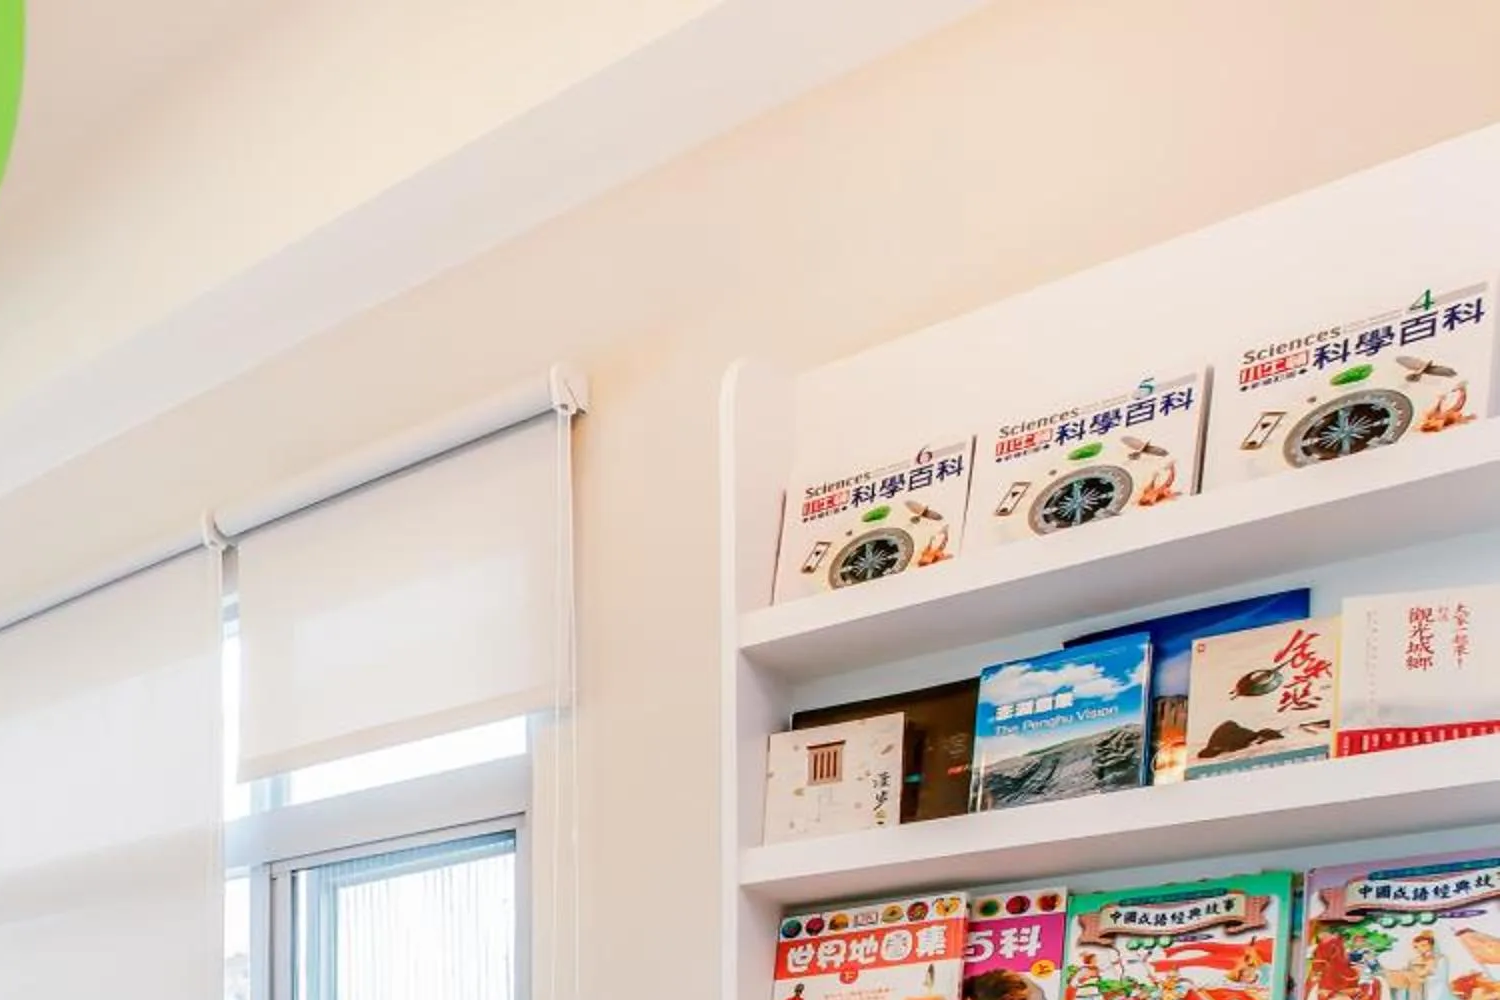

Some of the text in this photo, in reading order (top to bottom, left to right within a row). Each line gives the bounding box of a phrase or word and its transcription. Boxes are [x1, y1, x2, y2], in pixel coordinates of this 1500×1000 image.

[1408, 289, 1434, 311] 4
[1243, 326, 1341, 365] Sciences
[1312, 297, 1485, 371] 科學百科
[1136, 377, 1155, 398] 5
[999, 407, 1079, 438] Sciences
[1054, 387, 1194, 446] 科學百科
[916, 445, 933, 465] 6
[805, 471, 872, 499] Sciences
[851, 454, 964, 508] 科學百科
[995, 704, 1118, 736] The Penghu Vision
[1358, 871, 1500, 901] 中國成語經典故
[1110, 898, 1236, 927] 中國成語經典故事
[787, 925, 948, 973] 世界地圖集
